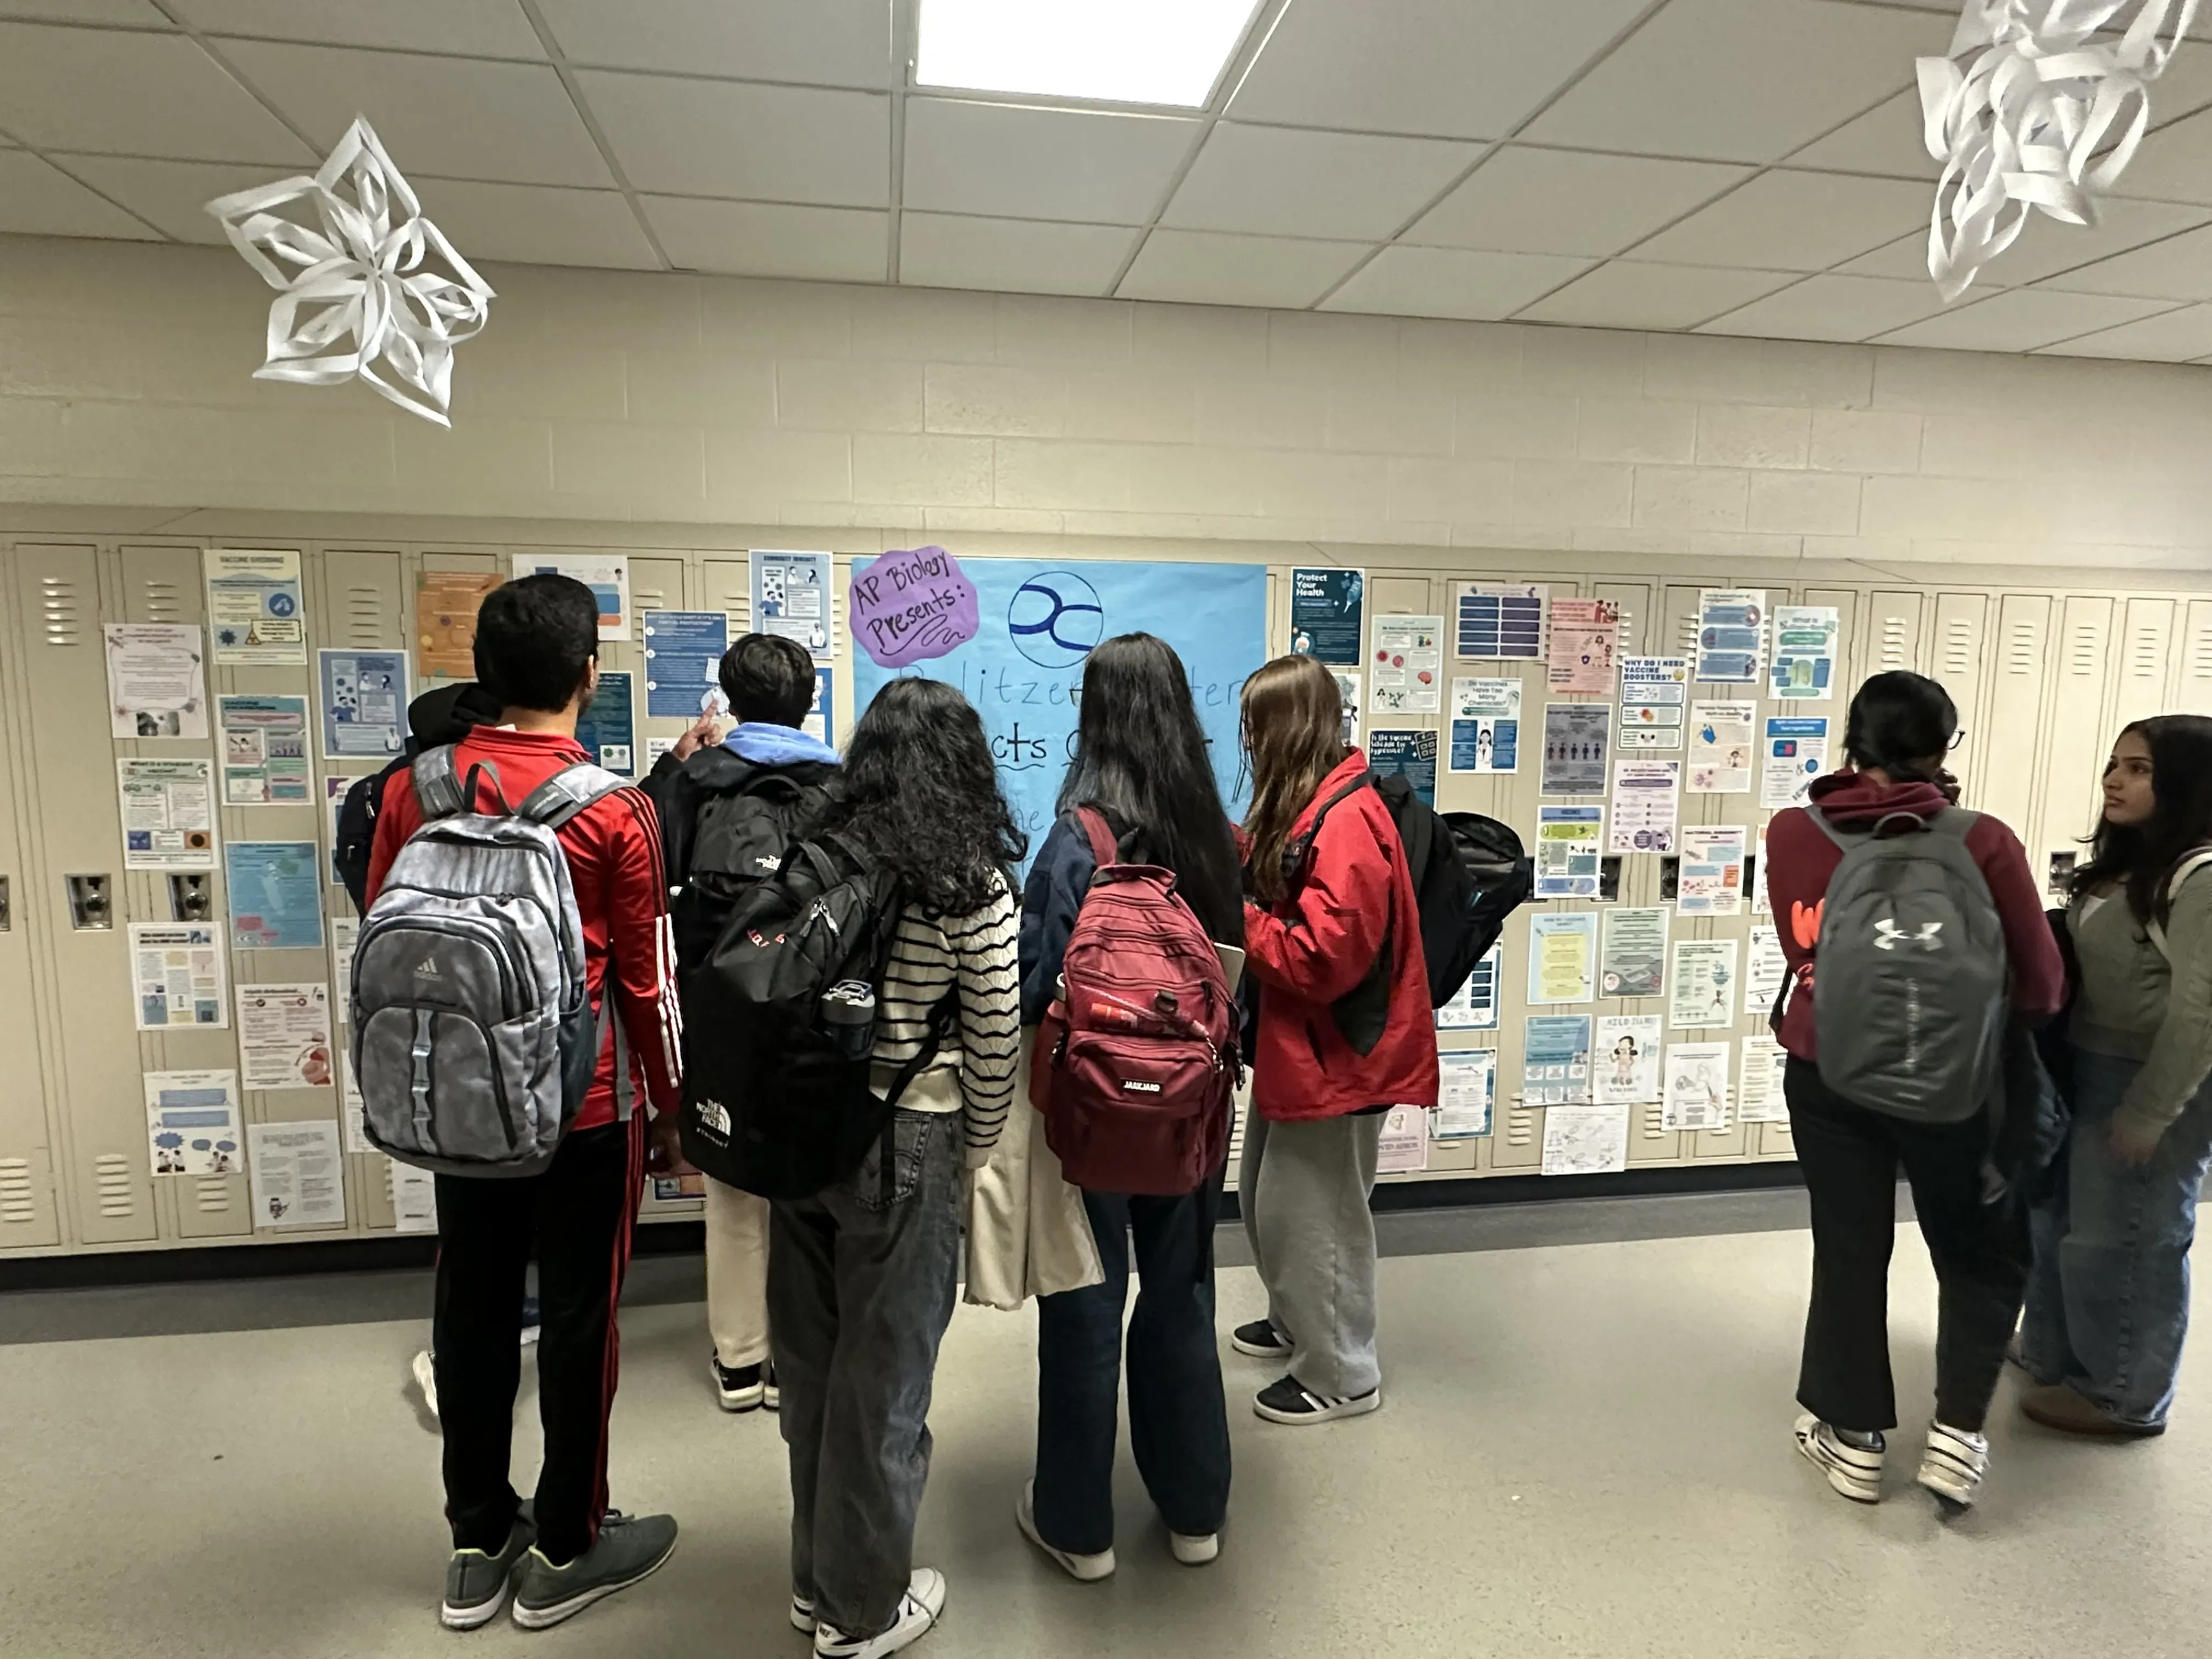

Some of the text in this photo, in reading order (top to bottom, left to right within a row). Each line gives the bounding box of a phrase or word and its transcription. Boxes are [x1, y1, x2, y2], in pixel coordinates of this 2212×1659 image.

[854, 551, 950, 616] AP Biology
[1296, 573, 1328, 582] Protect
[1296, 588, 1325, 597] Health
[866, 584, 965, 648] Presents:
